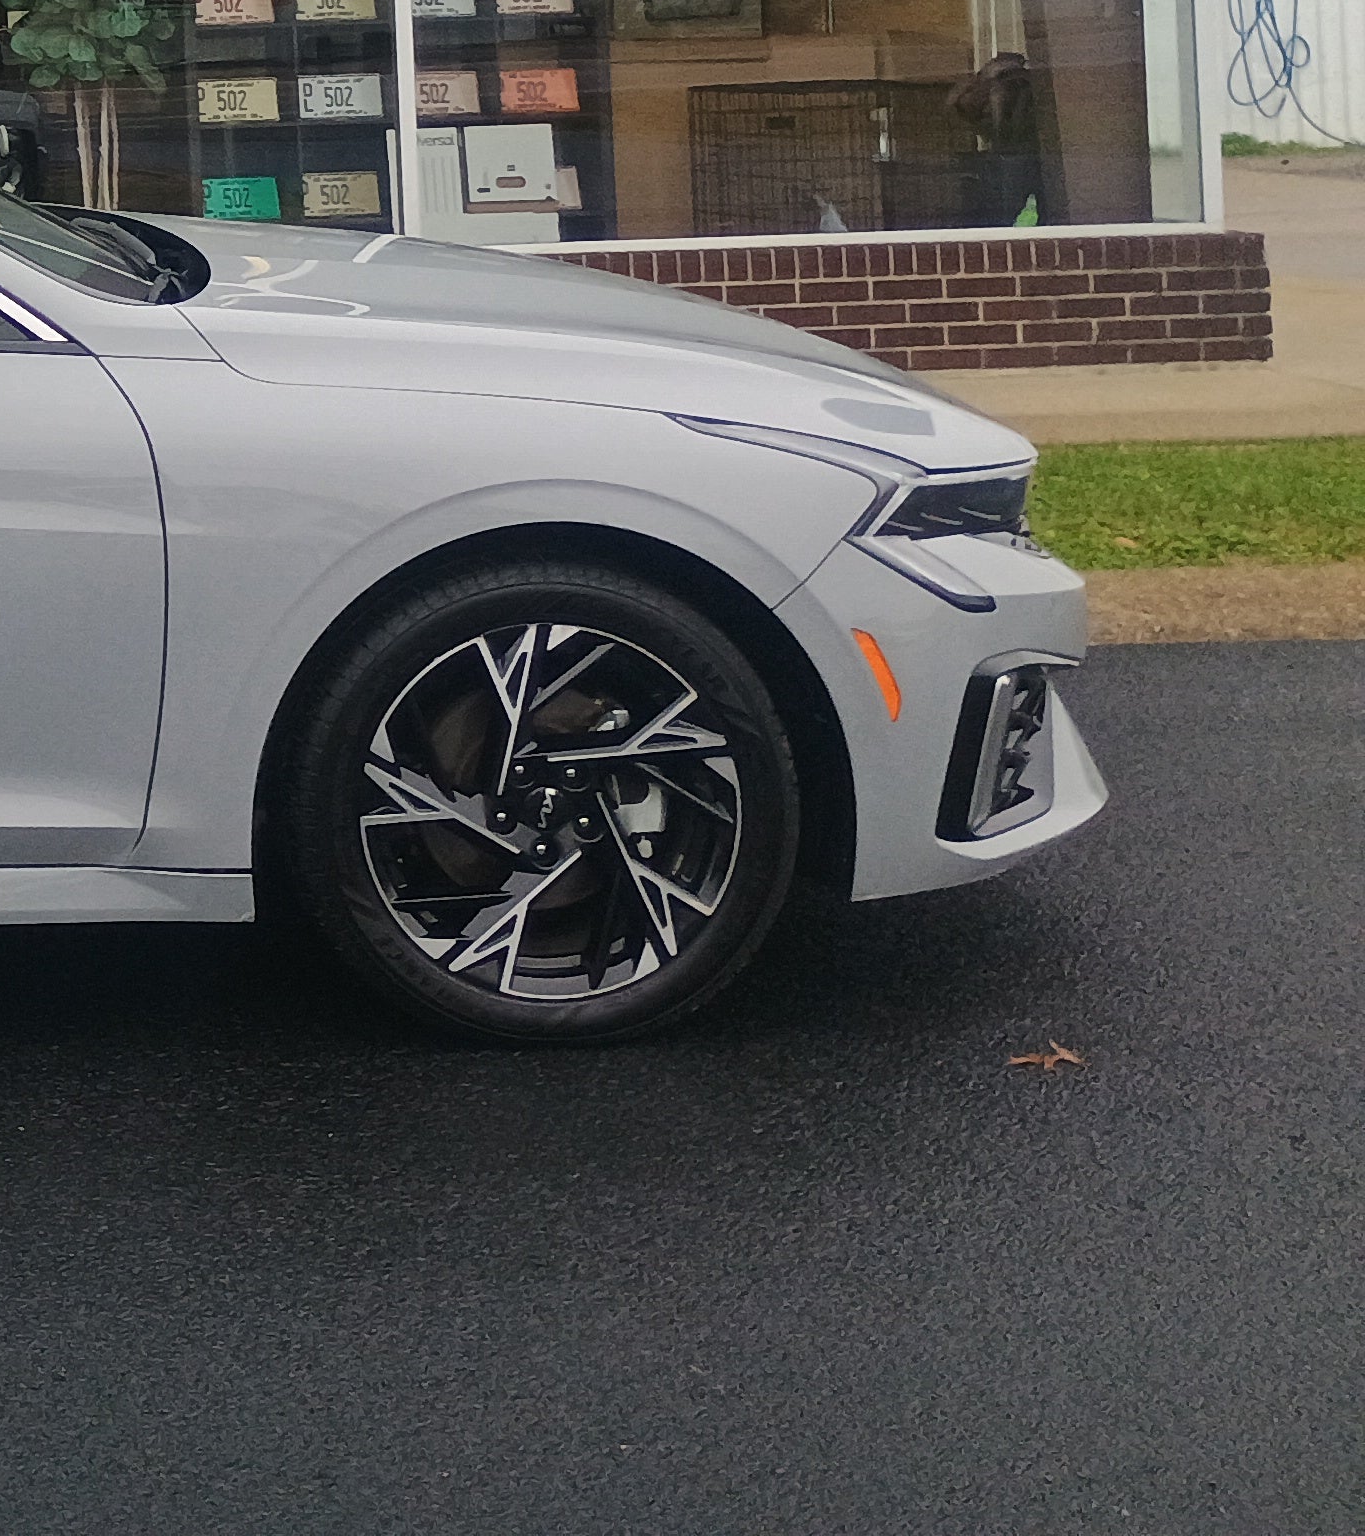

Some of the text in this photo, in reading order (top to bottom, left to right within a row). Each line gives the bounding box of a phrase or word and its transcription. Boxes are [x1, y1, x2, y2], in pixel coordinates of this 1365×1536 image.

[216, 89, 248, 111] 502
[323, 86, 354, 108] 502
[419, 82, 450, 104] 502
[516, 80, 548, 103] 502
[222, 187, 253, 209] 502
[319, 183, 350, 206] 502
